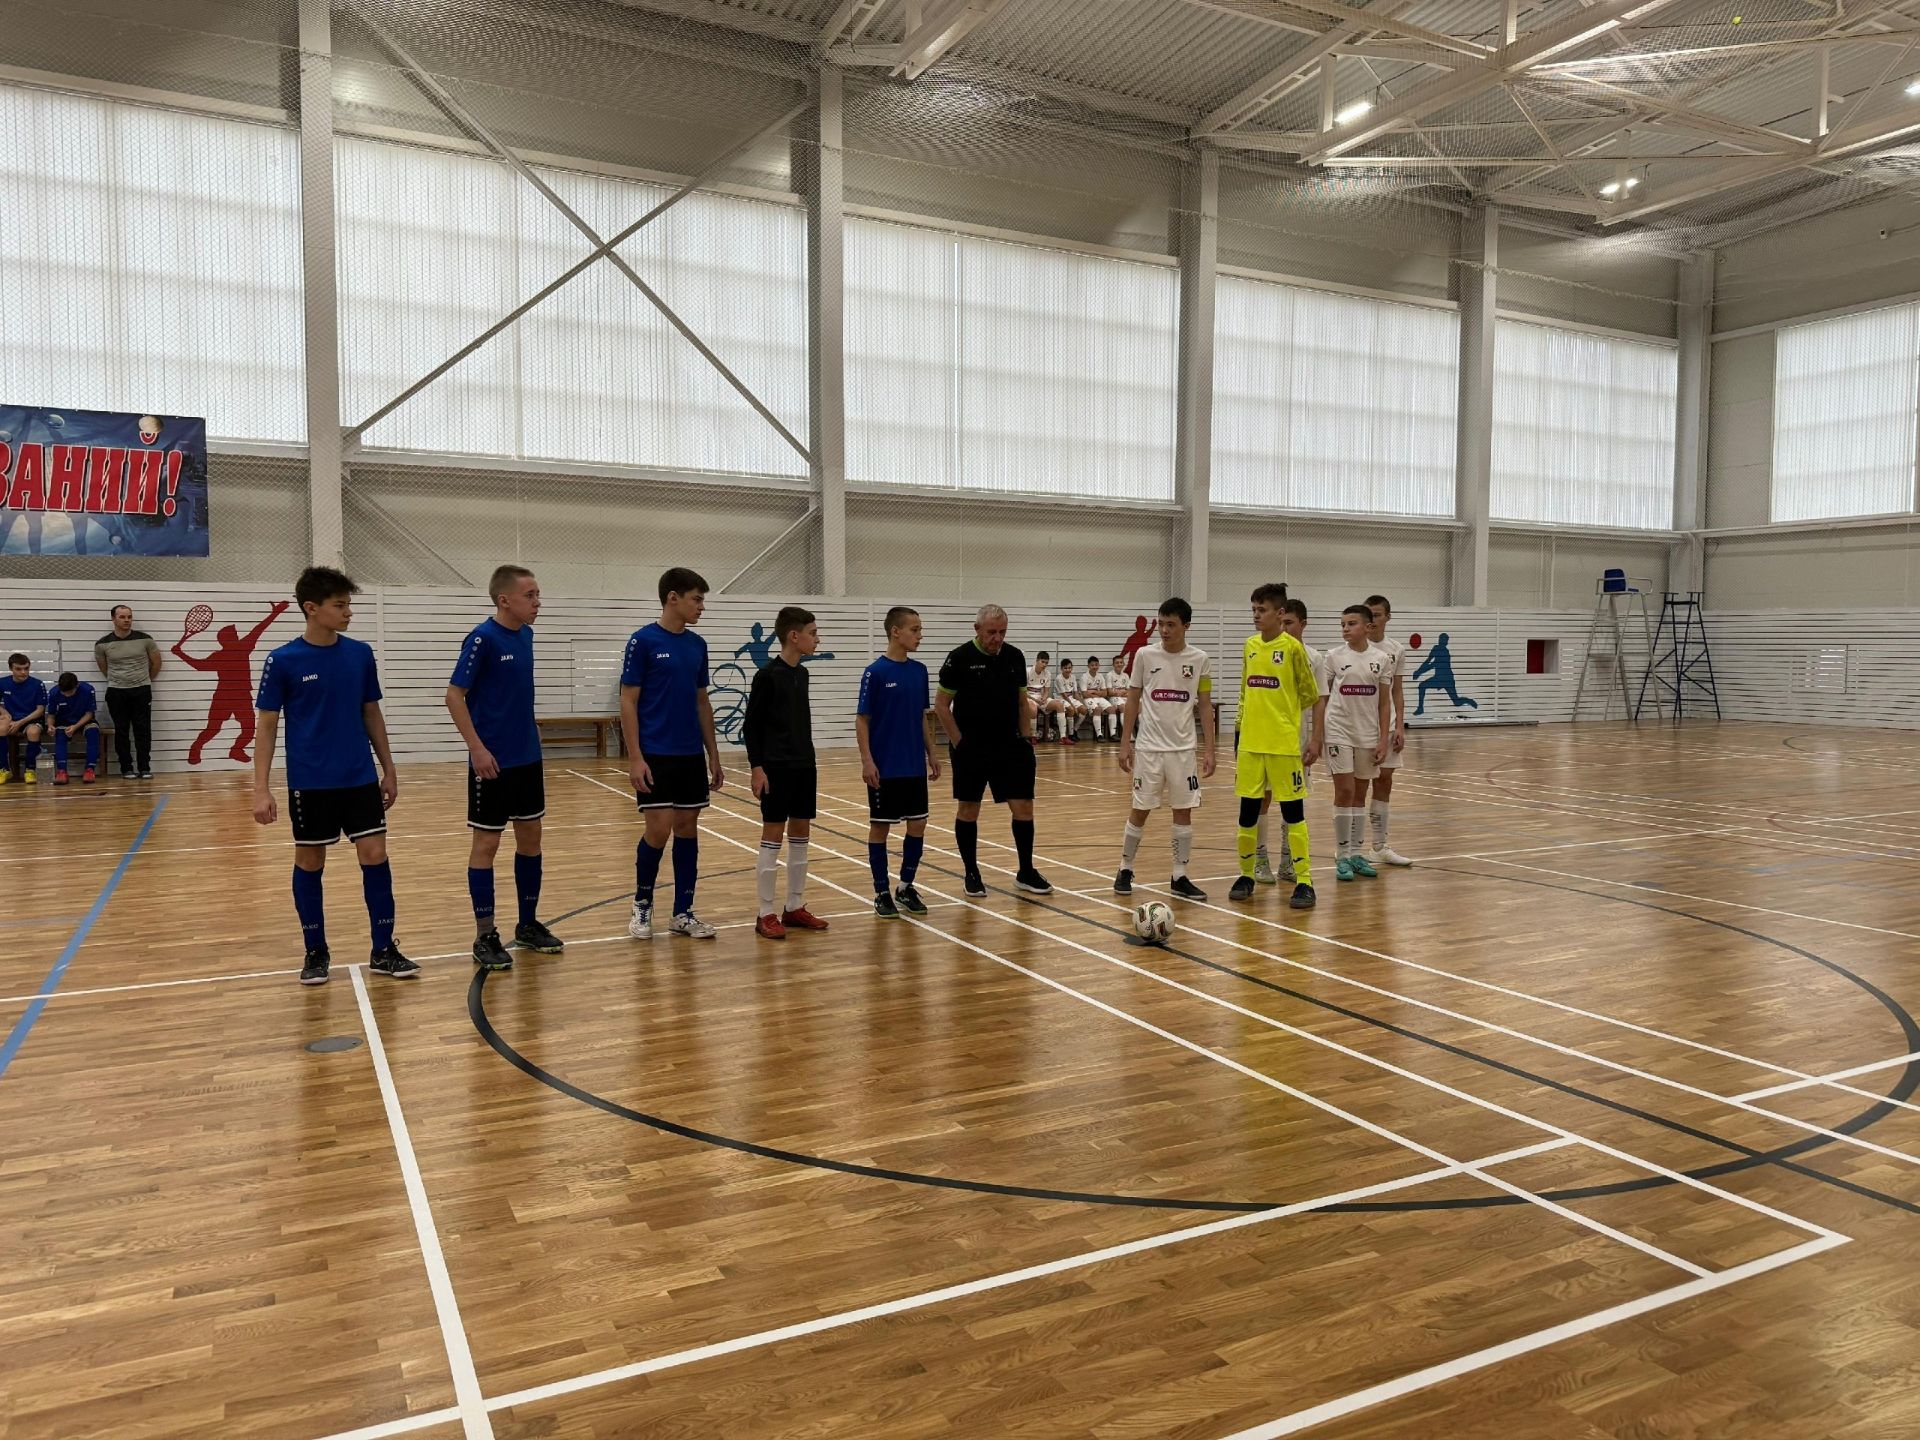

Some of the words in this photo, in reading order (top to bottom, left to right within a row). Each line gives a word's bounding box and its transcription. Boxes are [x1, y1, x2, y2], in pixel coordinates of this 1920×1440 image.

[302, 673, 319, 682] JAKO
[1187, 775, 1198, 791] 10
[1292, 770, 1302, 786] 16
